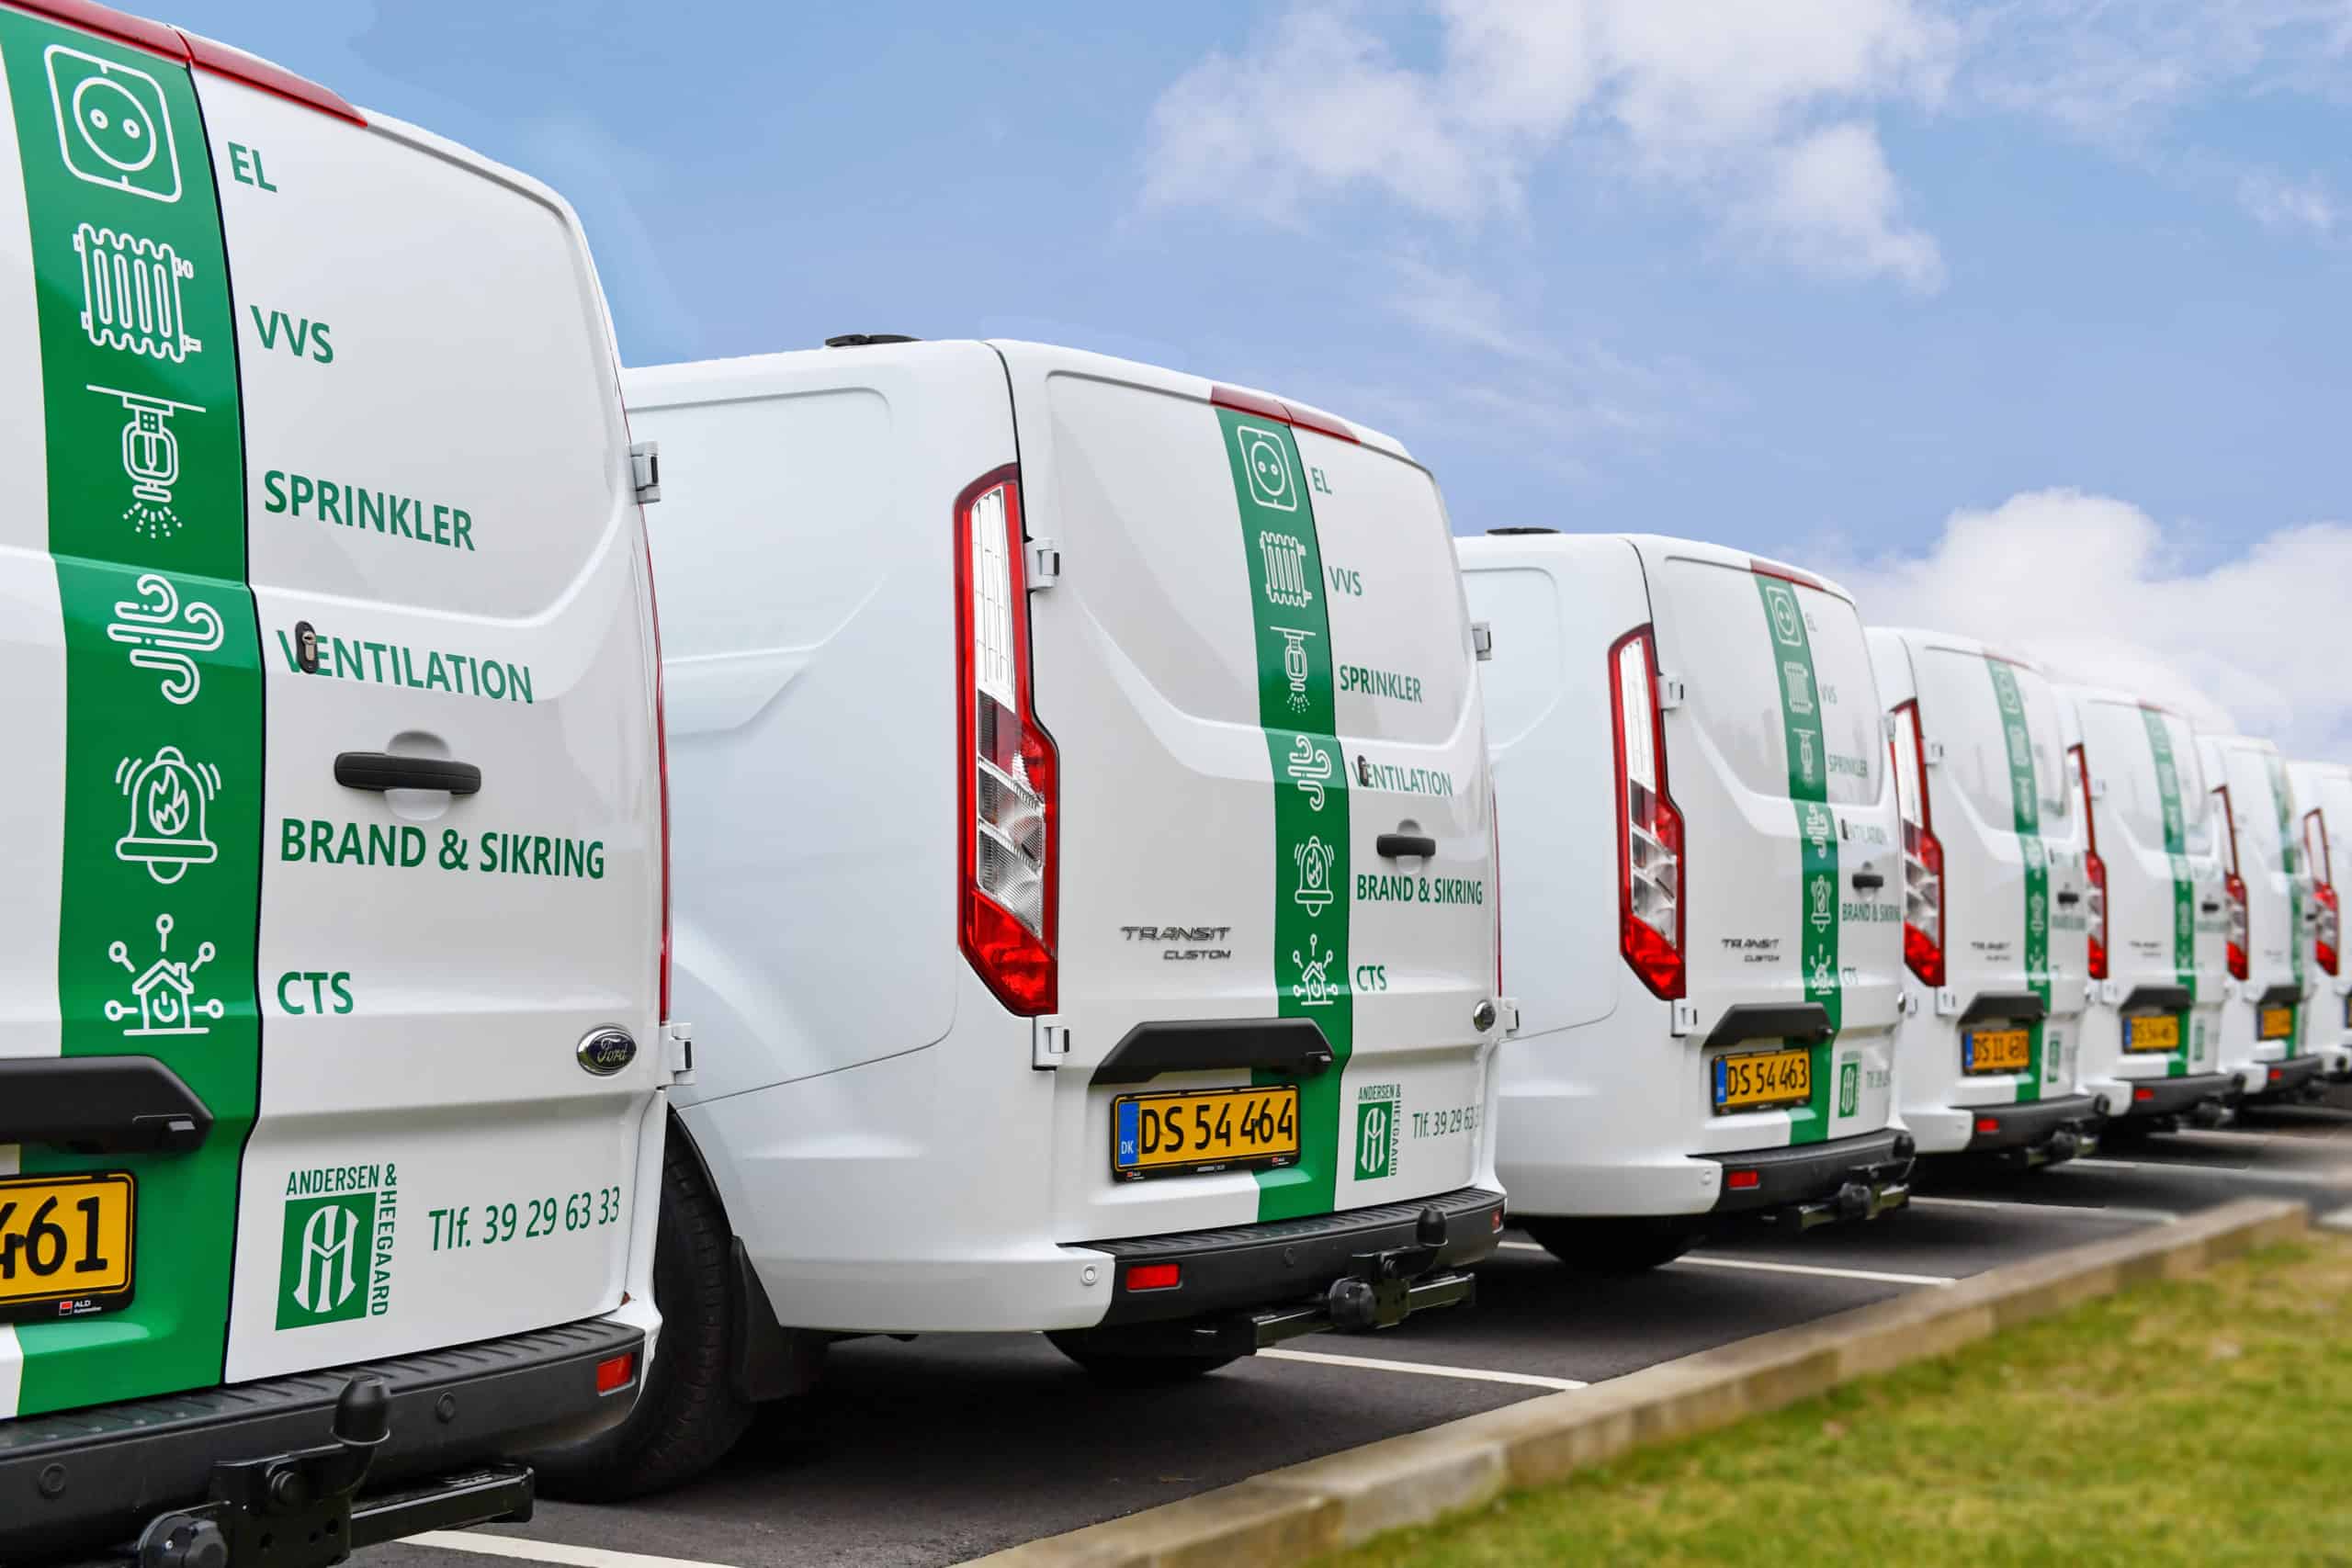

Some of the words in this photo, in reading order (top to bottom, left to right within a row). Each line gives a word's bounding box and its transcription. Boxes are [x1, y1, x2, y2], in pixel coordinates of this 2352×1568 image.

[228, 141, 278, 193] EL
[250, 304, 334, 364] VVS
[1310, 468, 1332, 495] EL
[264, 468, 476, 551] SPRINKLER
[1329, 566, 1363, 596] VVS
[1340, 664, 1423, 703] SPRINKLER
[279, 818, 427, 868] BRAND
[438, 829, 469, 872] &
[479, 830, 605, 880] SIKRING
[1357, 874, 1414, 902] BRAND
[1419, 878, 1431, 903] &
[1434, 877, 1483, 906] SIKRING
[1120, 926, 1231, 942] TRANSIT
[1162, 950, 1231, 961] CUSTOM
[277, 971, 355, 1015] CTS
[1356, 965, 1387, 992] CTS
[1358, 1084, 1396, 1100] ANDERSEN
[1727, 1064, 1750, 1097] DS
[1756, 1062, 1775, 1094] 54
[1779, 1058, 1807, 1091] 463
[1141, 1106, 1184, 1155] DS
[1194, 1103, 1231, 1150] 54
[1240, 1098, 1293, 1145] 464
[1433, 1111, 1448, 1136] 39
[1449, 1109, 1463, 1134] 29
[1121, 1141, 1135, 1155] DK
[286, 1164, 379, 1195] ANDERSEN
[385, 1163, 397, 1187] &
[428, 1206, 471, 1251] Tlf.
[482, 1203, 517, 1245] 39
[526, 1199, 557, 1238] 29
[565, 1191, 593, 1232] 63
[598, 1186, 620, 1224] 33
[371, 1190, 397, 1316] HEEGAARD
